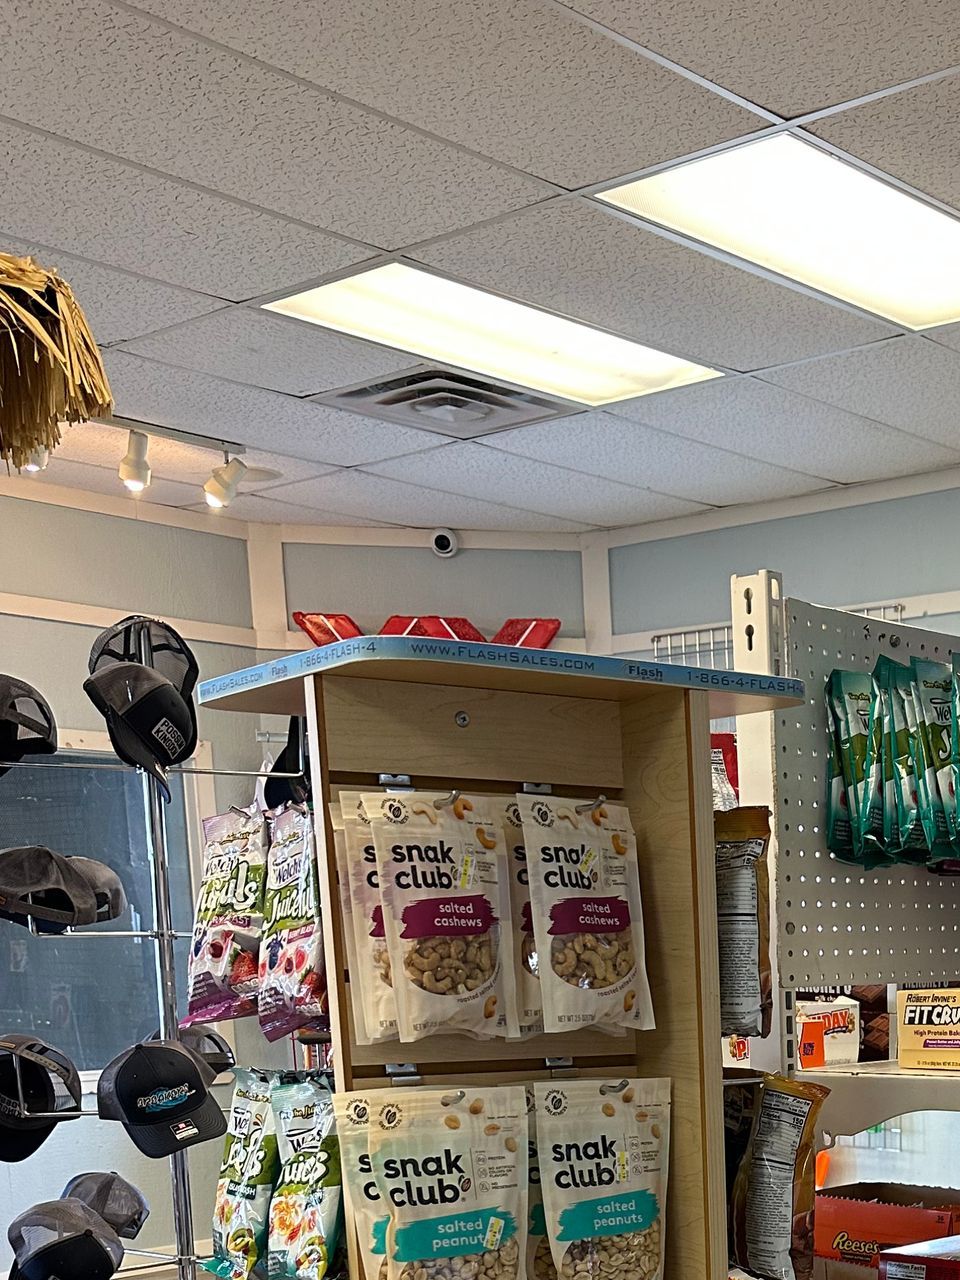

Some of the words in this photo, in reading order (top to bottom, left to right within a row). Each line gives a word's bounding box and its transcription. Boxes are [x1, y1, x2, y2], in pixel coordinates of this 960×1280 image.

[628, 664, 664, 679] Flash
[391, 840, 456, 865] snak
[394, 864, 453, 890] club
[543, 864, 593, 890] club
[439, 902, 474, 914] salted
[582, 902, 611, 914] salted
[434, 916, 483, 927] cashews
[578, 914, 620, 926] cashews
[906, 993, 931, 1003] ROBERT
[931, 994, 957, 1003] IRVINE'S
[913, 1030, 926, 1038] High
[792, 1116, 804, 1126] 150
[551, 1134, 617, 1163] snak
[383, 1148, 466, 1179] snak
[554, 1163, 615, 1190] club
[389, 1178, 460, 1208] club
[596, 1200, 636, 1214] salted
[437, 1218, 483, 1234] salted
[593, 1212, 643, 1231] peanuts
[832, 1231, 880, 1255] Reese's
